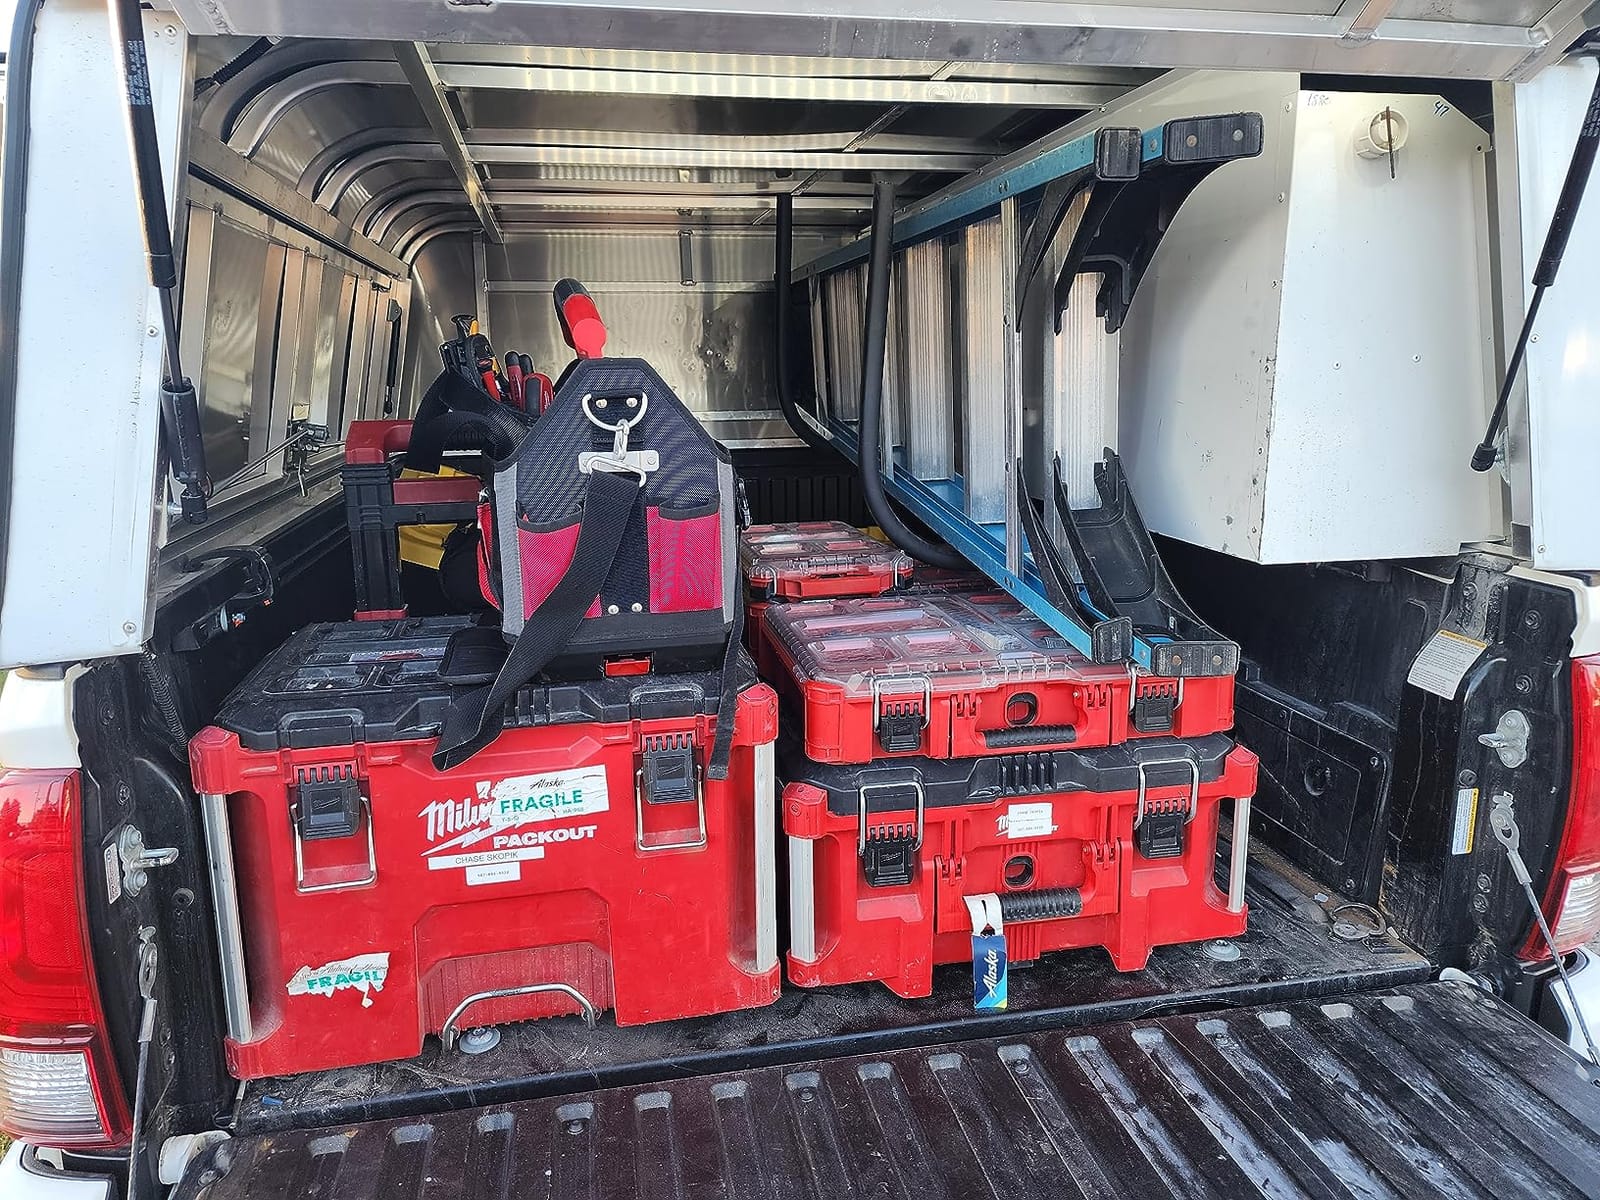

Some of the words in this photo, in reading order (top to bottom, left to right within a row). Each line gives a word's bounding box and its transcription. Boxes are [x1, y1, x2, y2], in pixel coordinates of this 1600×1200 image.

[500, 790, 583, 814] FRAGILE
[493, 825, 598, 849] PACKOUT
[455, 855, 485, 864] CHASE
[486, 851, 519, 862] SKOPIK
[306, 970, 383, 989] FRAGIL
